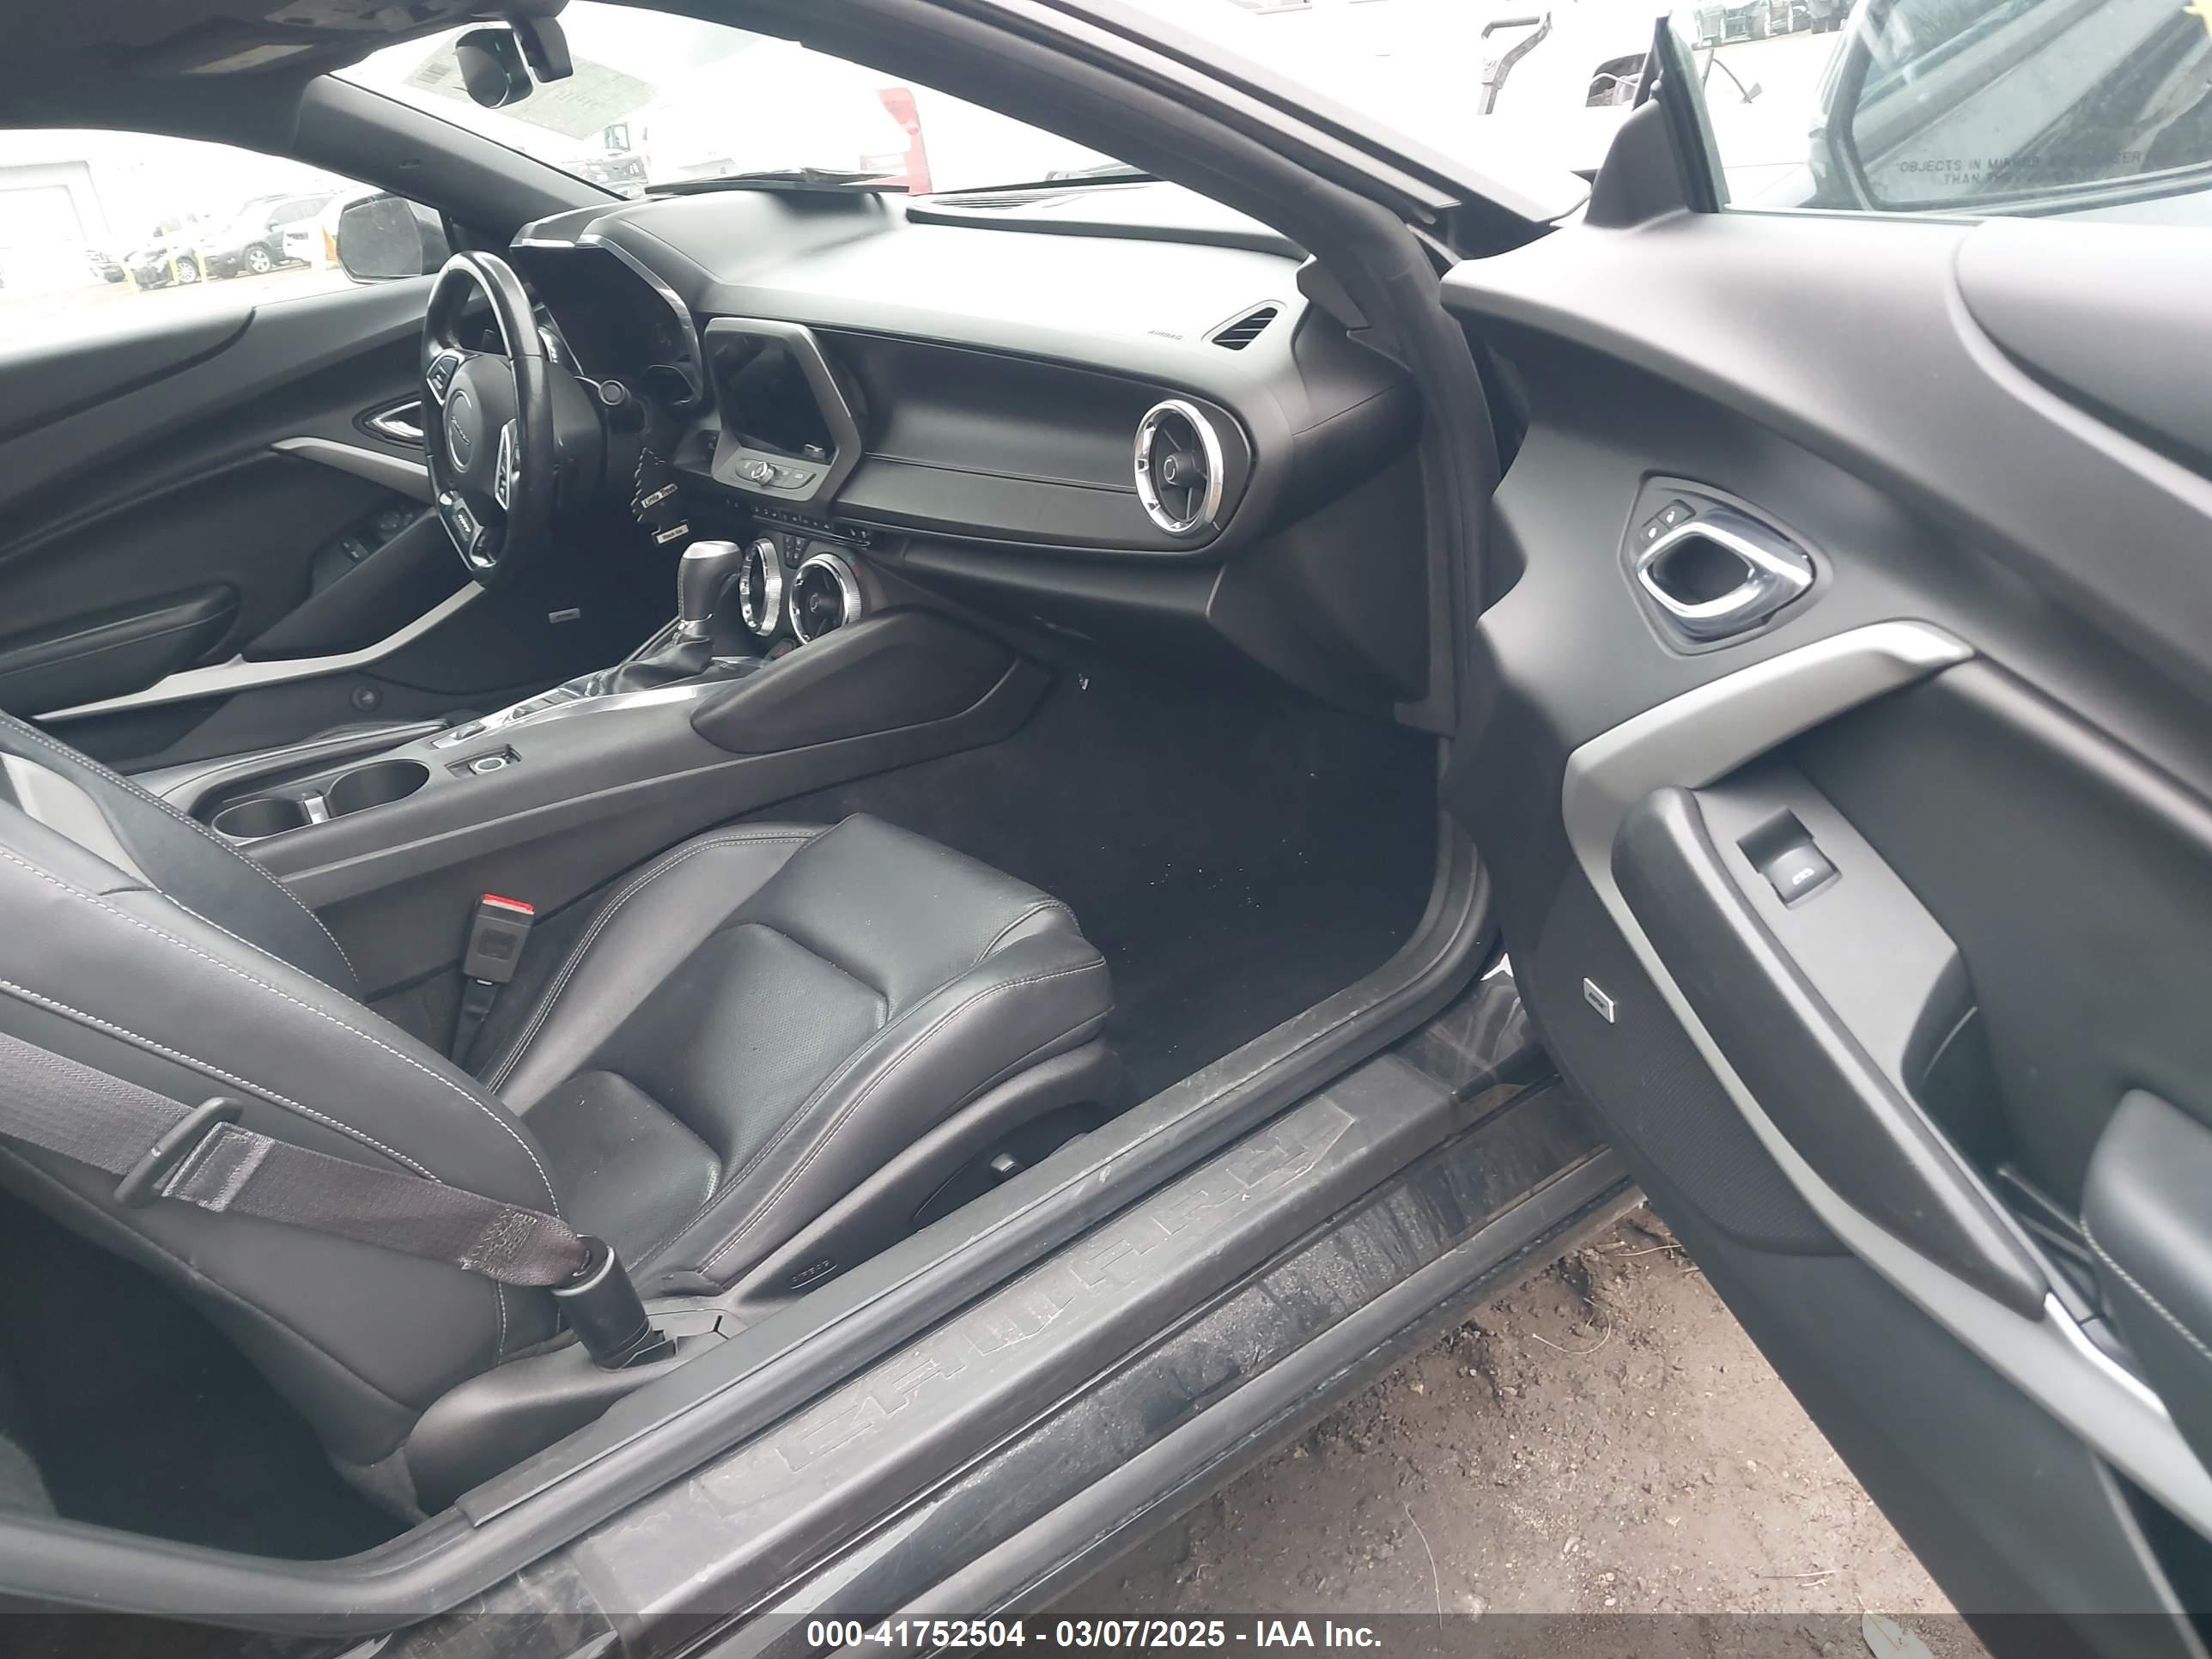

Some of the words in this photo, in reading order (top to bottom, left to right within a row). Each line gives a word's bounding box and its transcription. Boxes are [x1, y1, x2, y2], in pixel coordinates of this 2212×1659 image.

[1899, 158, 1962, 173] OBJECTS
[1969, 157, 1982, 171] IN
[1944, 172, 1980, 186] THAN
[1146, 329, 1184, 341] AIRBAG
[775, 1132, 1310, 1474] CAMARO
